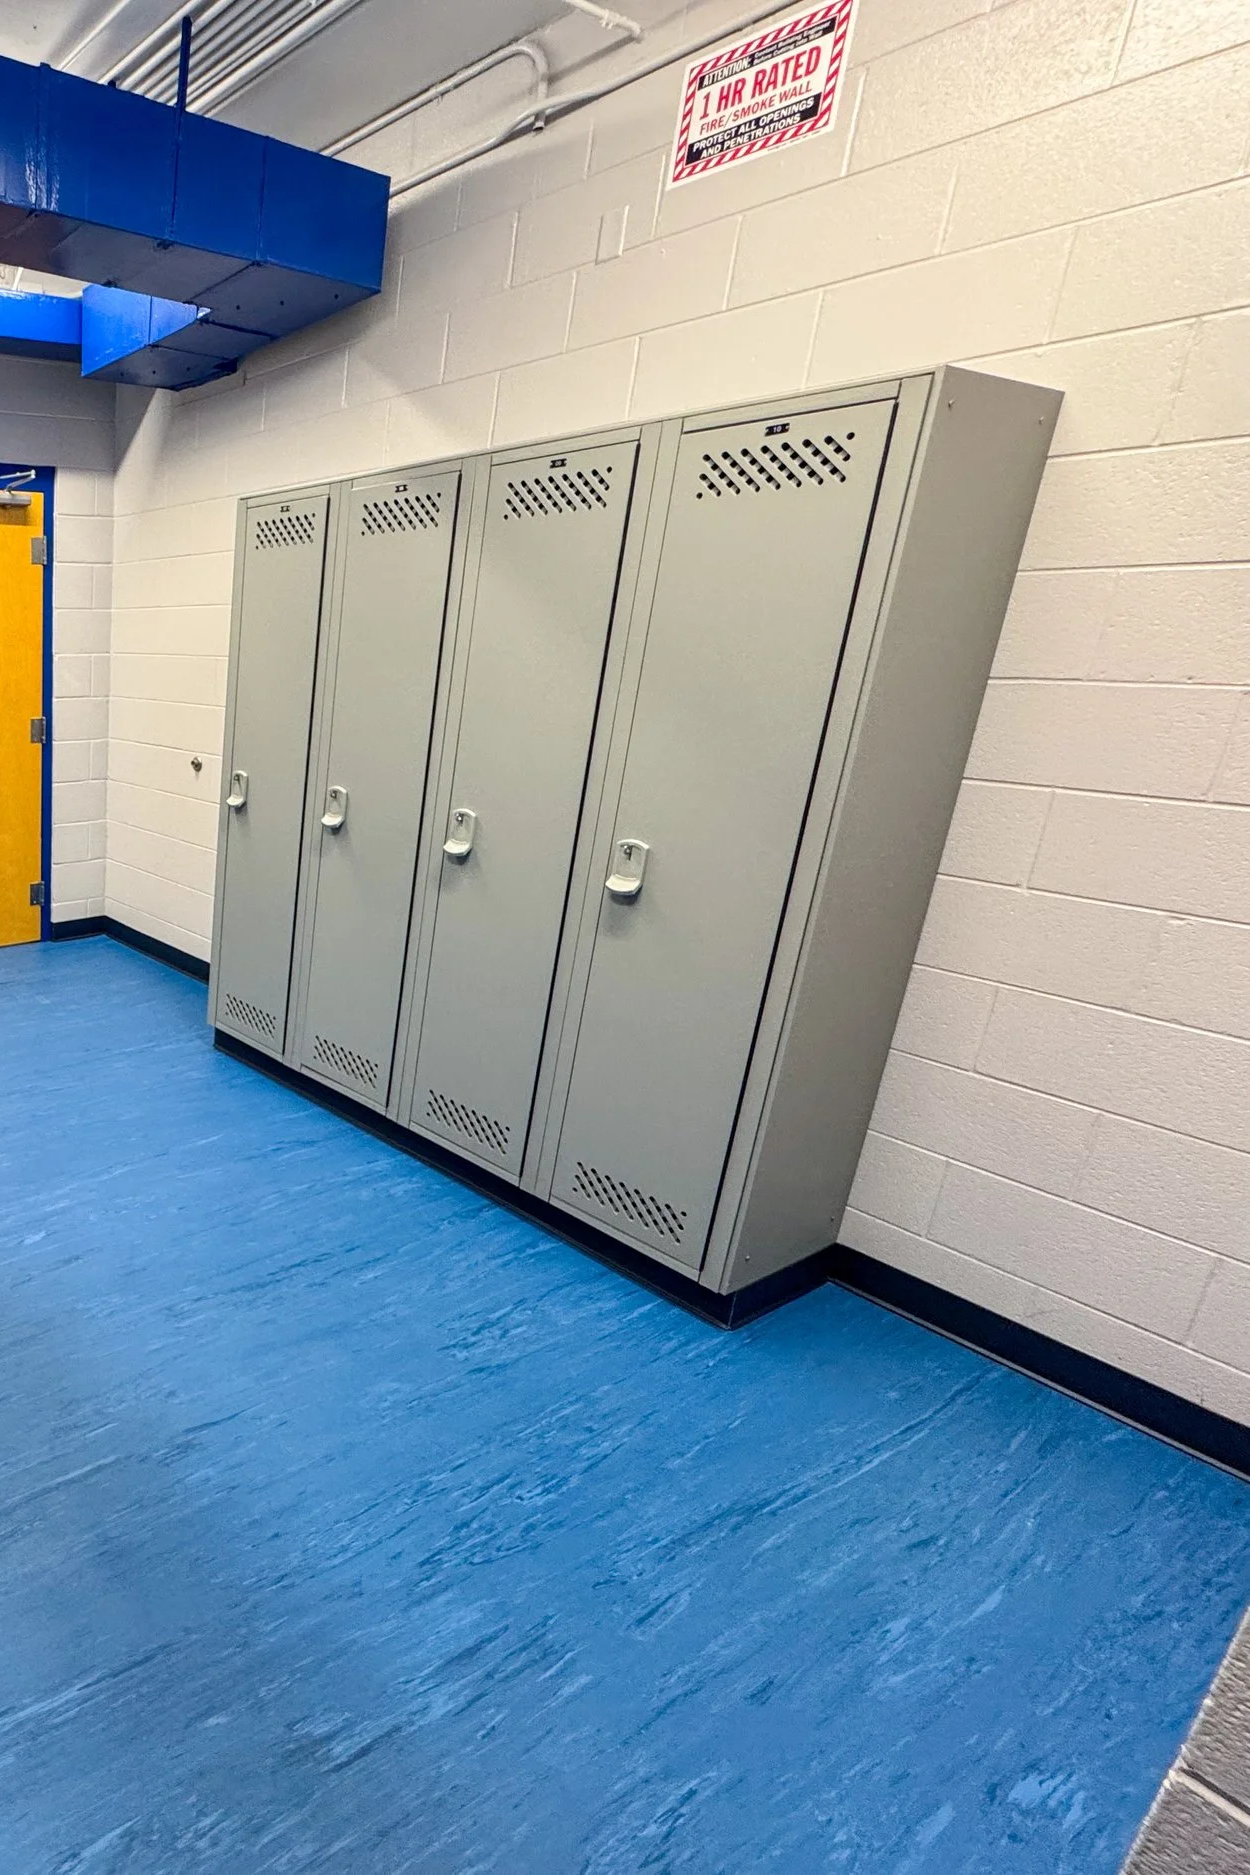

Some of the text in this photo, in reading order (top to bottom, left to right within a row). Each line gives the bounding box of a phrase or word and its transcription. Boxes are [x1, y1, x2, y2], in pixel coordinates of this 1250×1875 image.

[700, 46, 821, 120] 1 HR RATED
[702, 57, 752, 87] ATTENTION:
[693, 126, 736, 152] PROTECT
[738, 119, 758, 135] ALL
[759, 97, 814, 125] OPENINGS
[700, 80, 812, 135] FIRE/SMOKE WALL
[700, 143, 723, 159] AND
[723, 113, 801, 150] PENETRATIONS
[773, 425, 782, 433] 10
